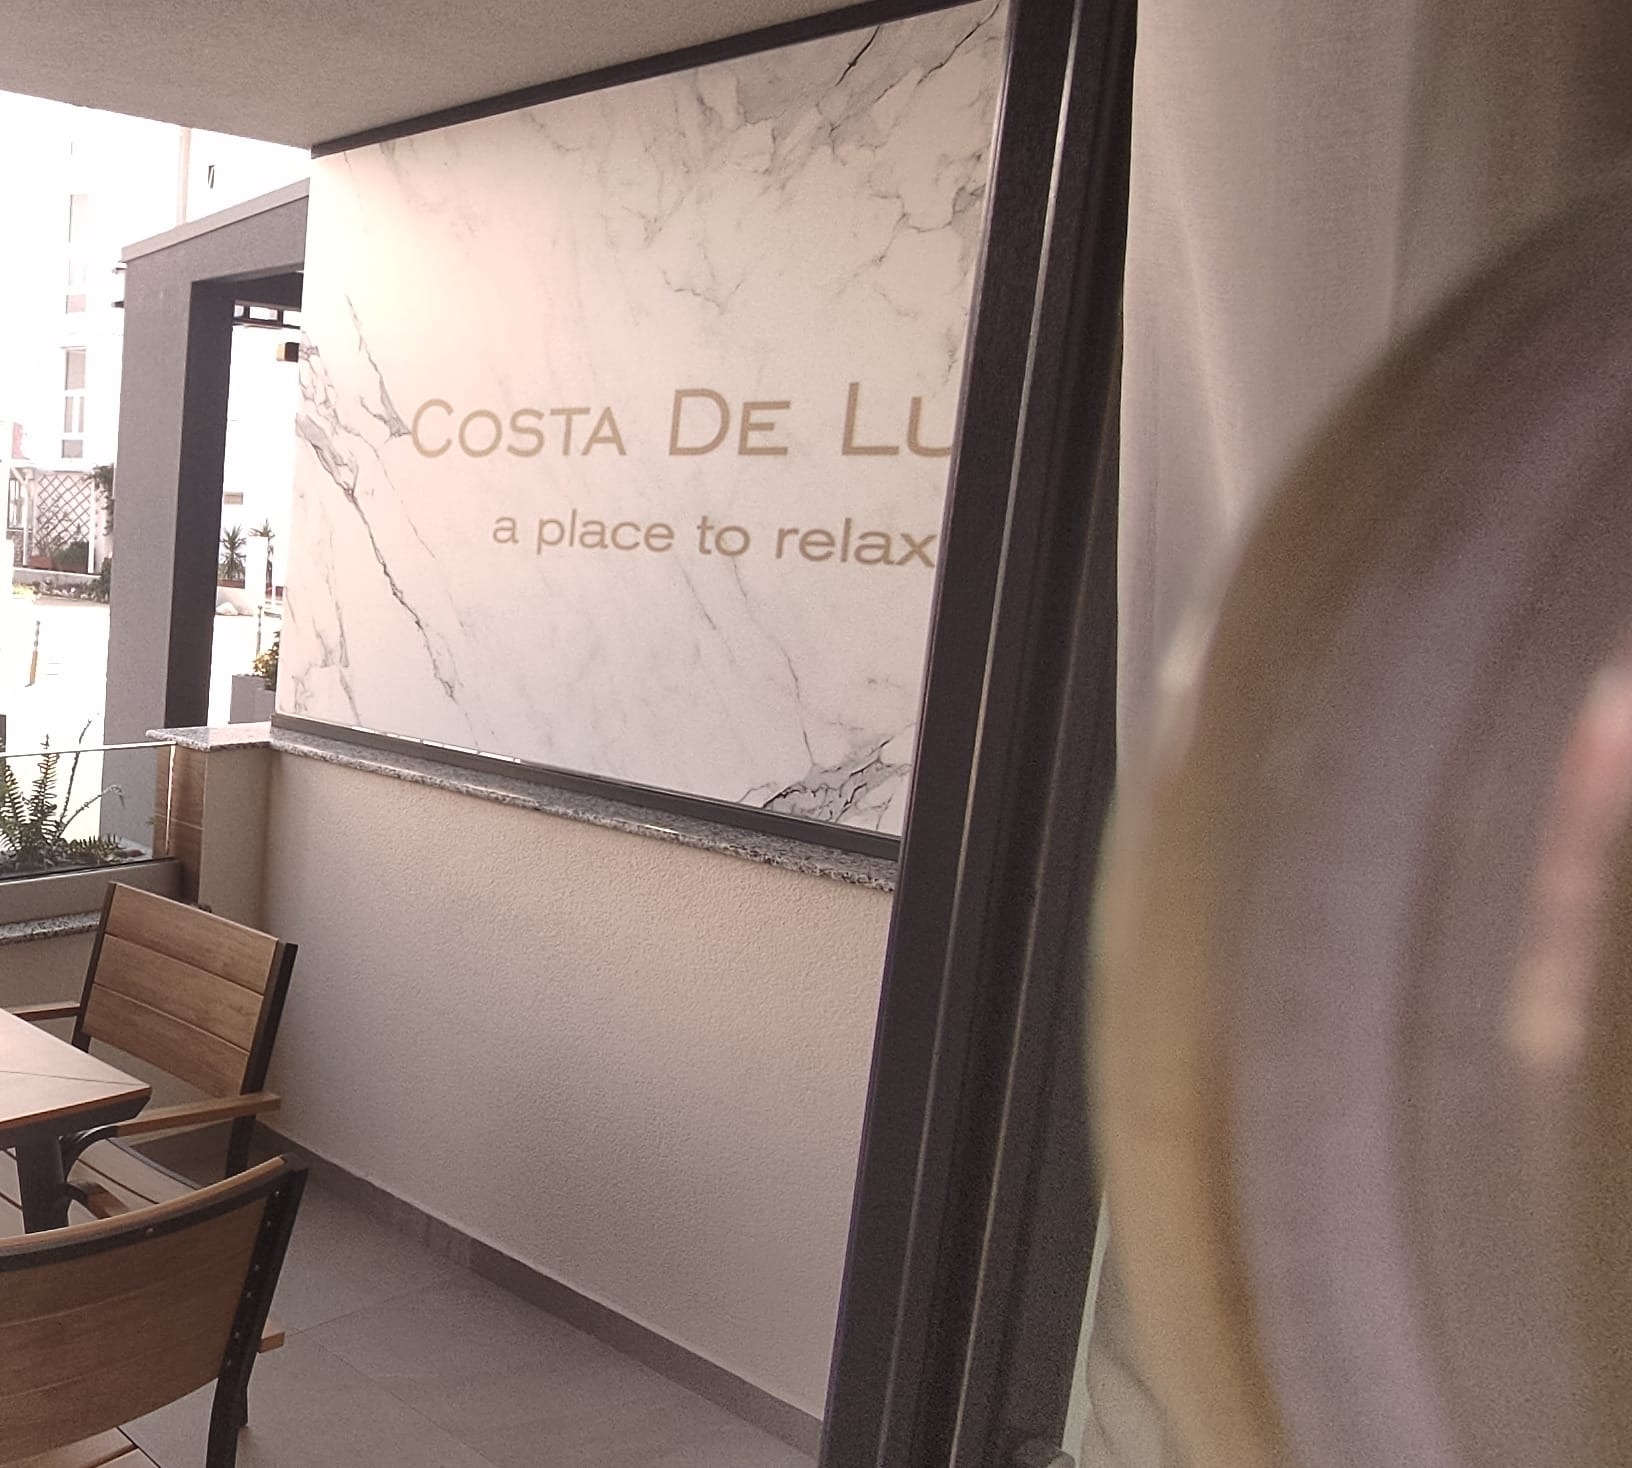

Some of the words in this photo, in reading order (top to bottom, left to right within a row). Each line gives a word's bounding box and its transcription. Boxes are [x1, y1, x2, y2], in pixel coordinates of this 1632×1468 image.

[411, 398, 627, 458] COSTA
[669, 388, 791, 456] DE
[492, 516, 519, 545] a
[537, 509, 675, 555] place
[697, 516, 751, 556] to
[775, 518, 938, 567] relax
